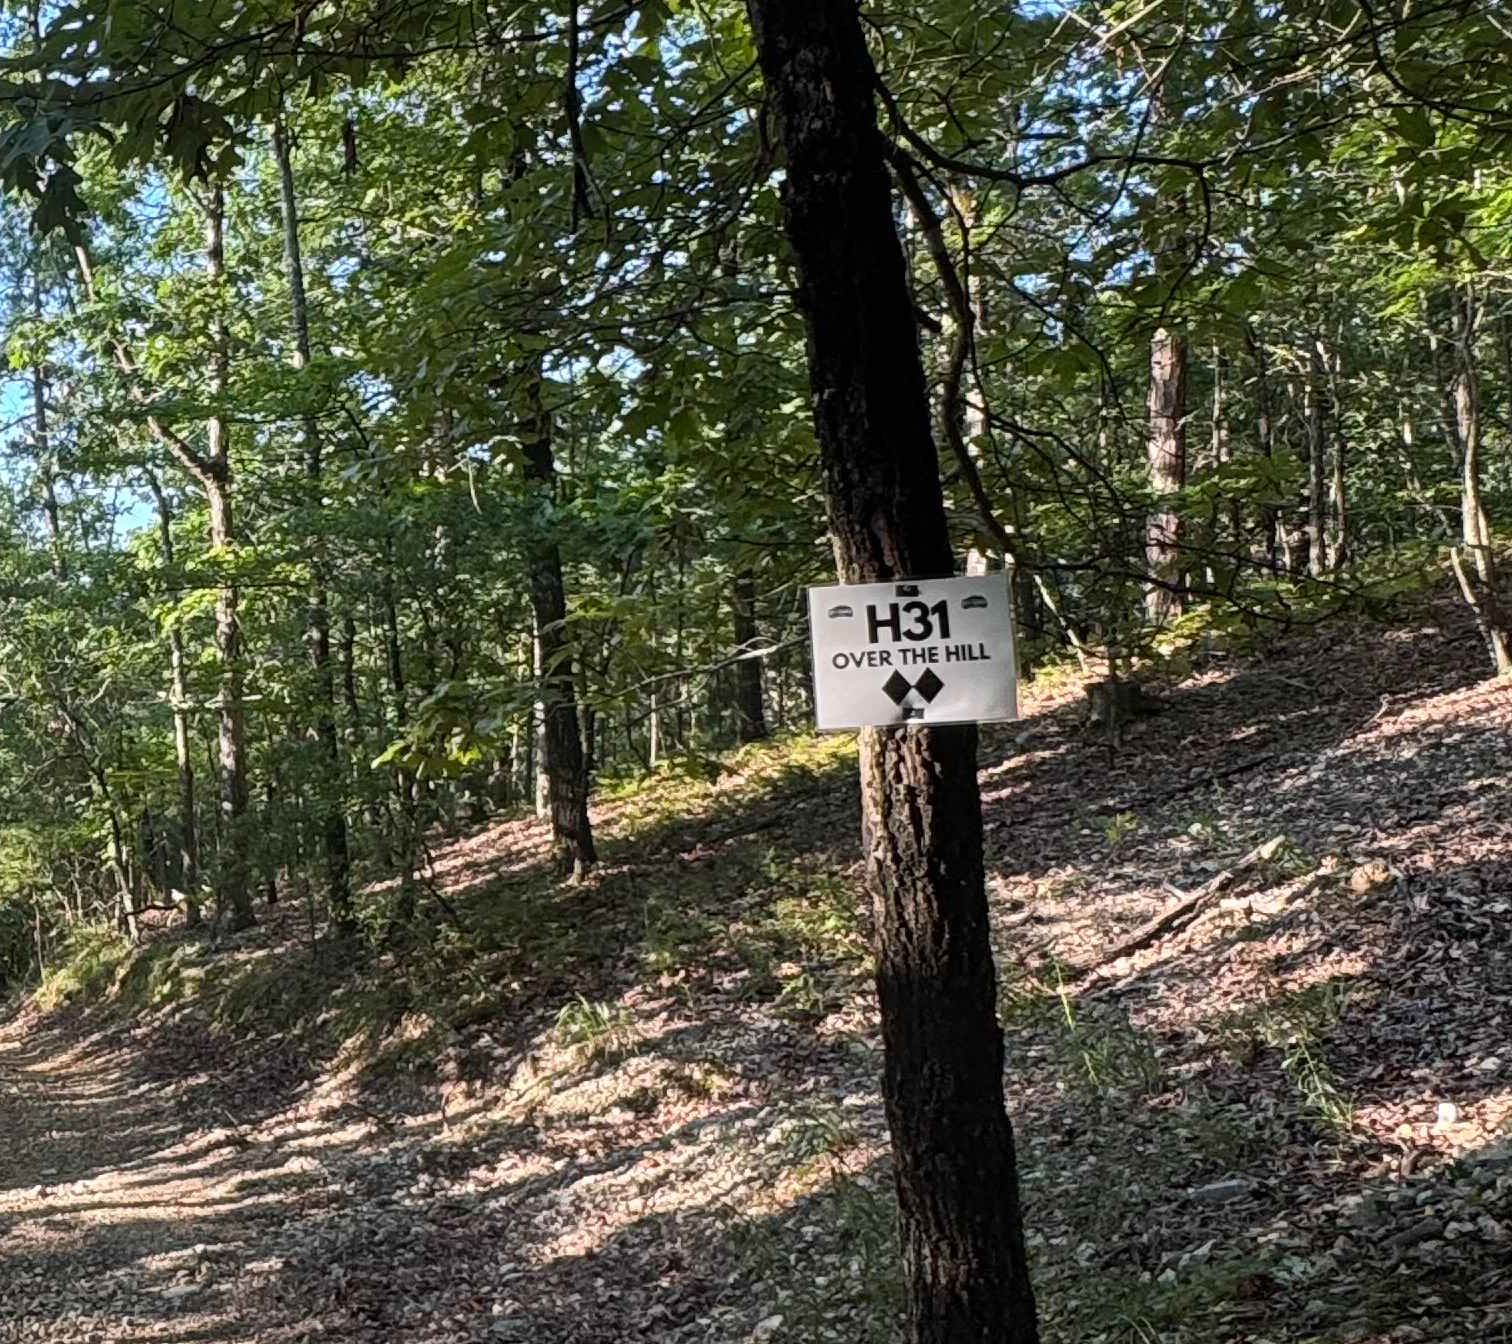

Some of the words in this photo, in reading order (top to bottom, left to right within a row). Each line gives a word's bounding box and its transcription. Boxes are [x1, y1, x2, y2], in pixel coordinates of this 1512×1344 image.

[866, 600, 951, 644] H31
[832, 650, 893, 669] OVER
[898, 646, 939, 665] THE
[945, 643, 990, 662] HILL
